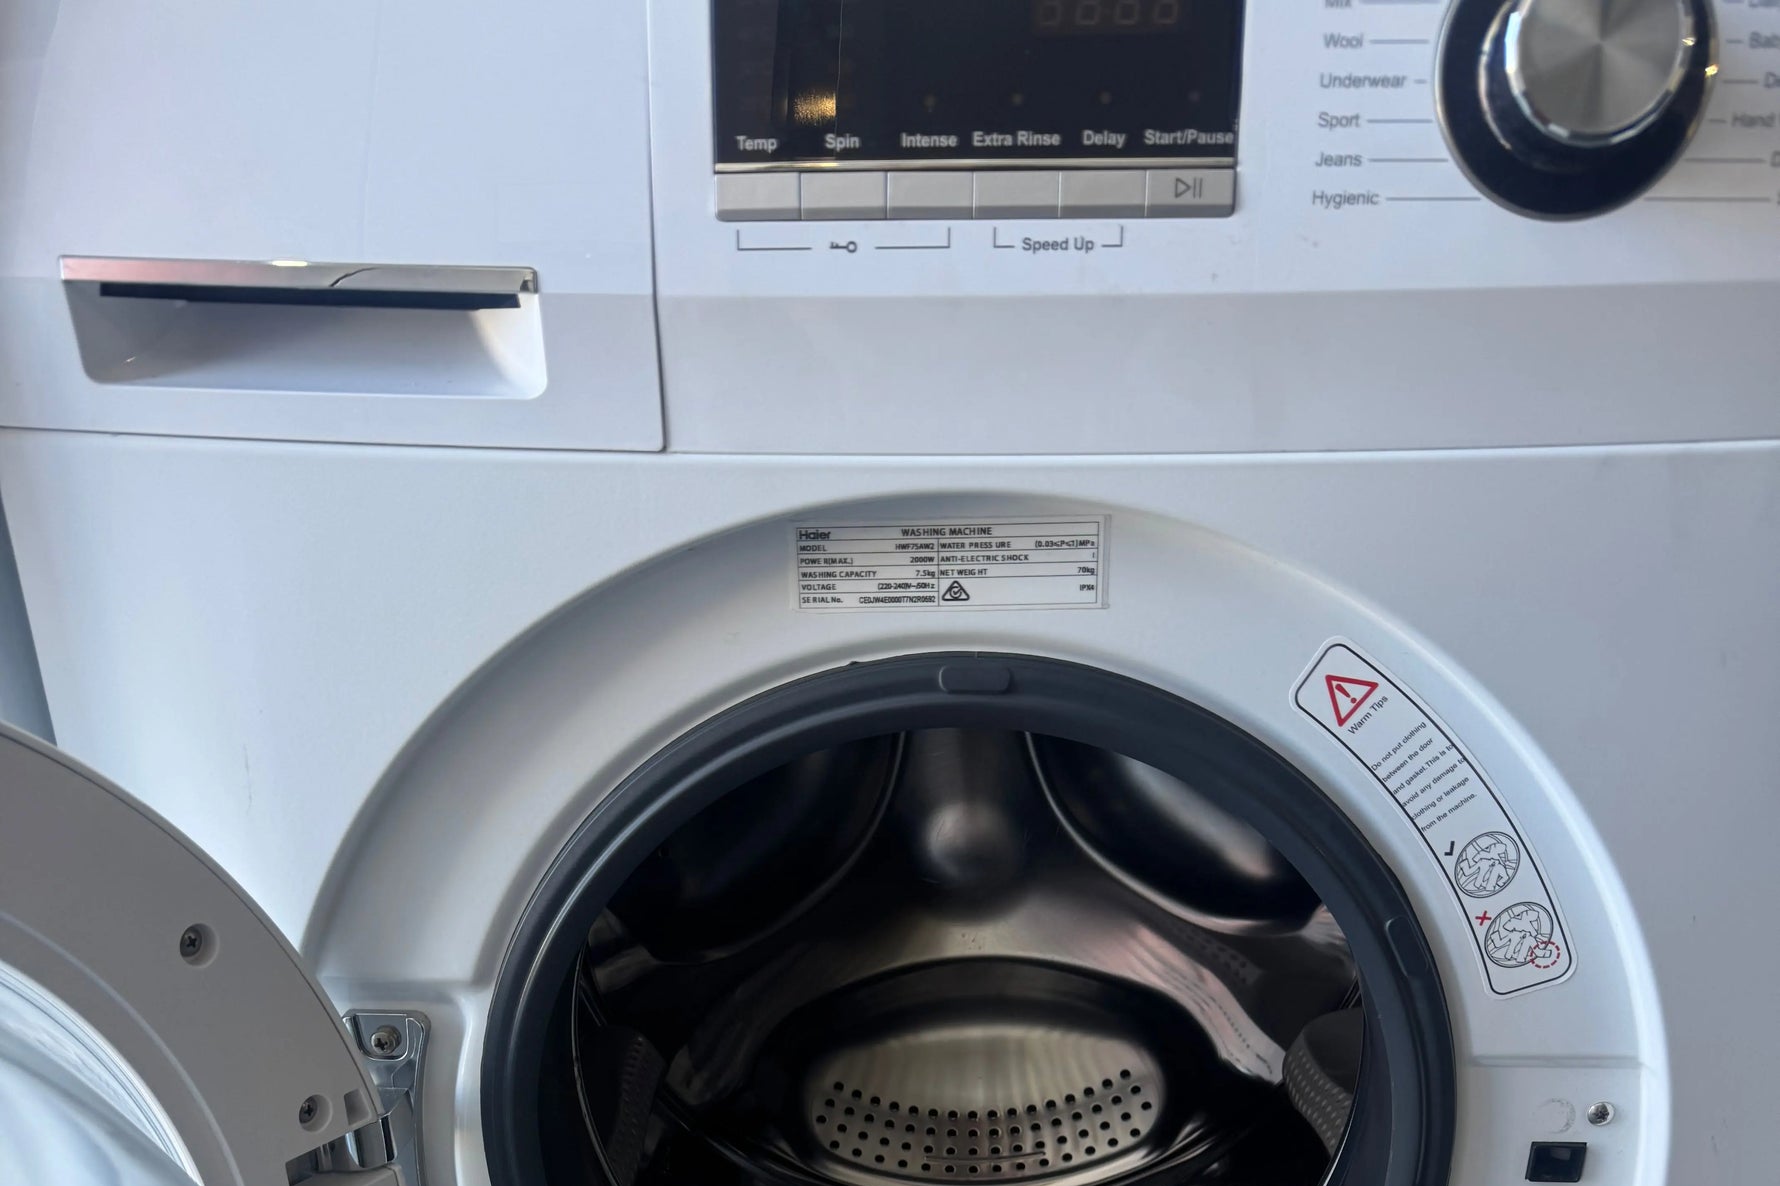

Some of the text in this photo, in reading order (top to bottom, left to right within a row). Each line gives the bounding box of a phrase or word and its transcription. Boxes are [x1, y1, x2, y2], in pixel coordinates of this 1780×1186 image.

[1323, 33, 1364, 49] Wool
[1319, 72, 1407, 89] Underwear
[1317, 112, 1361, 130] Sport
[1732, 113, 1776, 127] Hand
[736, 136, 778, 153] Temp
[824, 133, 860, 151] Spin
[901, 132, 958, 148] Intense
[972, 131, 1061, 147] Extra Rinse
[1082, 130, 1126, 149] Delay
[1143, 129, 1235, 147] Start/Pause
[1315, 152, 1362, 167] Jeans
[1312, 190, 1379, 208] Hygienic
[1022, 236, 1095, 254] Speed Up
[799, 529, 832, 540] Haier
[901, 527, 993, 537] WASHING MACHINE
[799, 544, 827, 552] MODEL
[940, 554, 999, 562] ANTI-ELECTRIC
[838, 570, 877, 578] CAPACITY
[1077, 566, 1095, 575] 70kg
[1348, 696, 1388, 734] Warm Tips
[1371, 721, 1427, 771] Do not put clothing
[1382, 737, 1433, 783] between the door
[1393, 783, 1405, 795] and
[1439, 749, 1446, 757] is
[1402, 792, 1419, 808] avoid
[1420, 782, 1432, 794] any
[1432, 763, 1458, 784] damage
[1412, 777, 1470, 820] clothing or leakage
[1421, 793, 1477, 833] from the machine.
